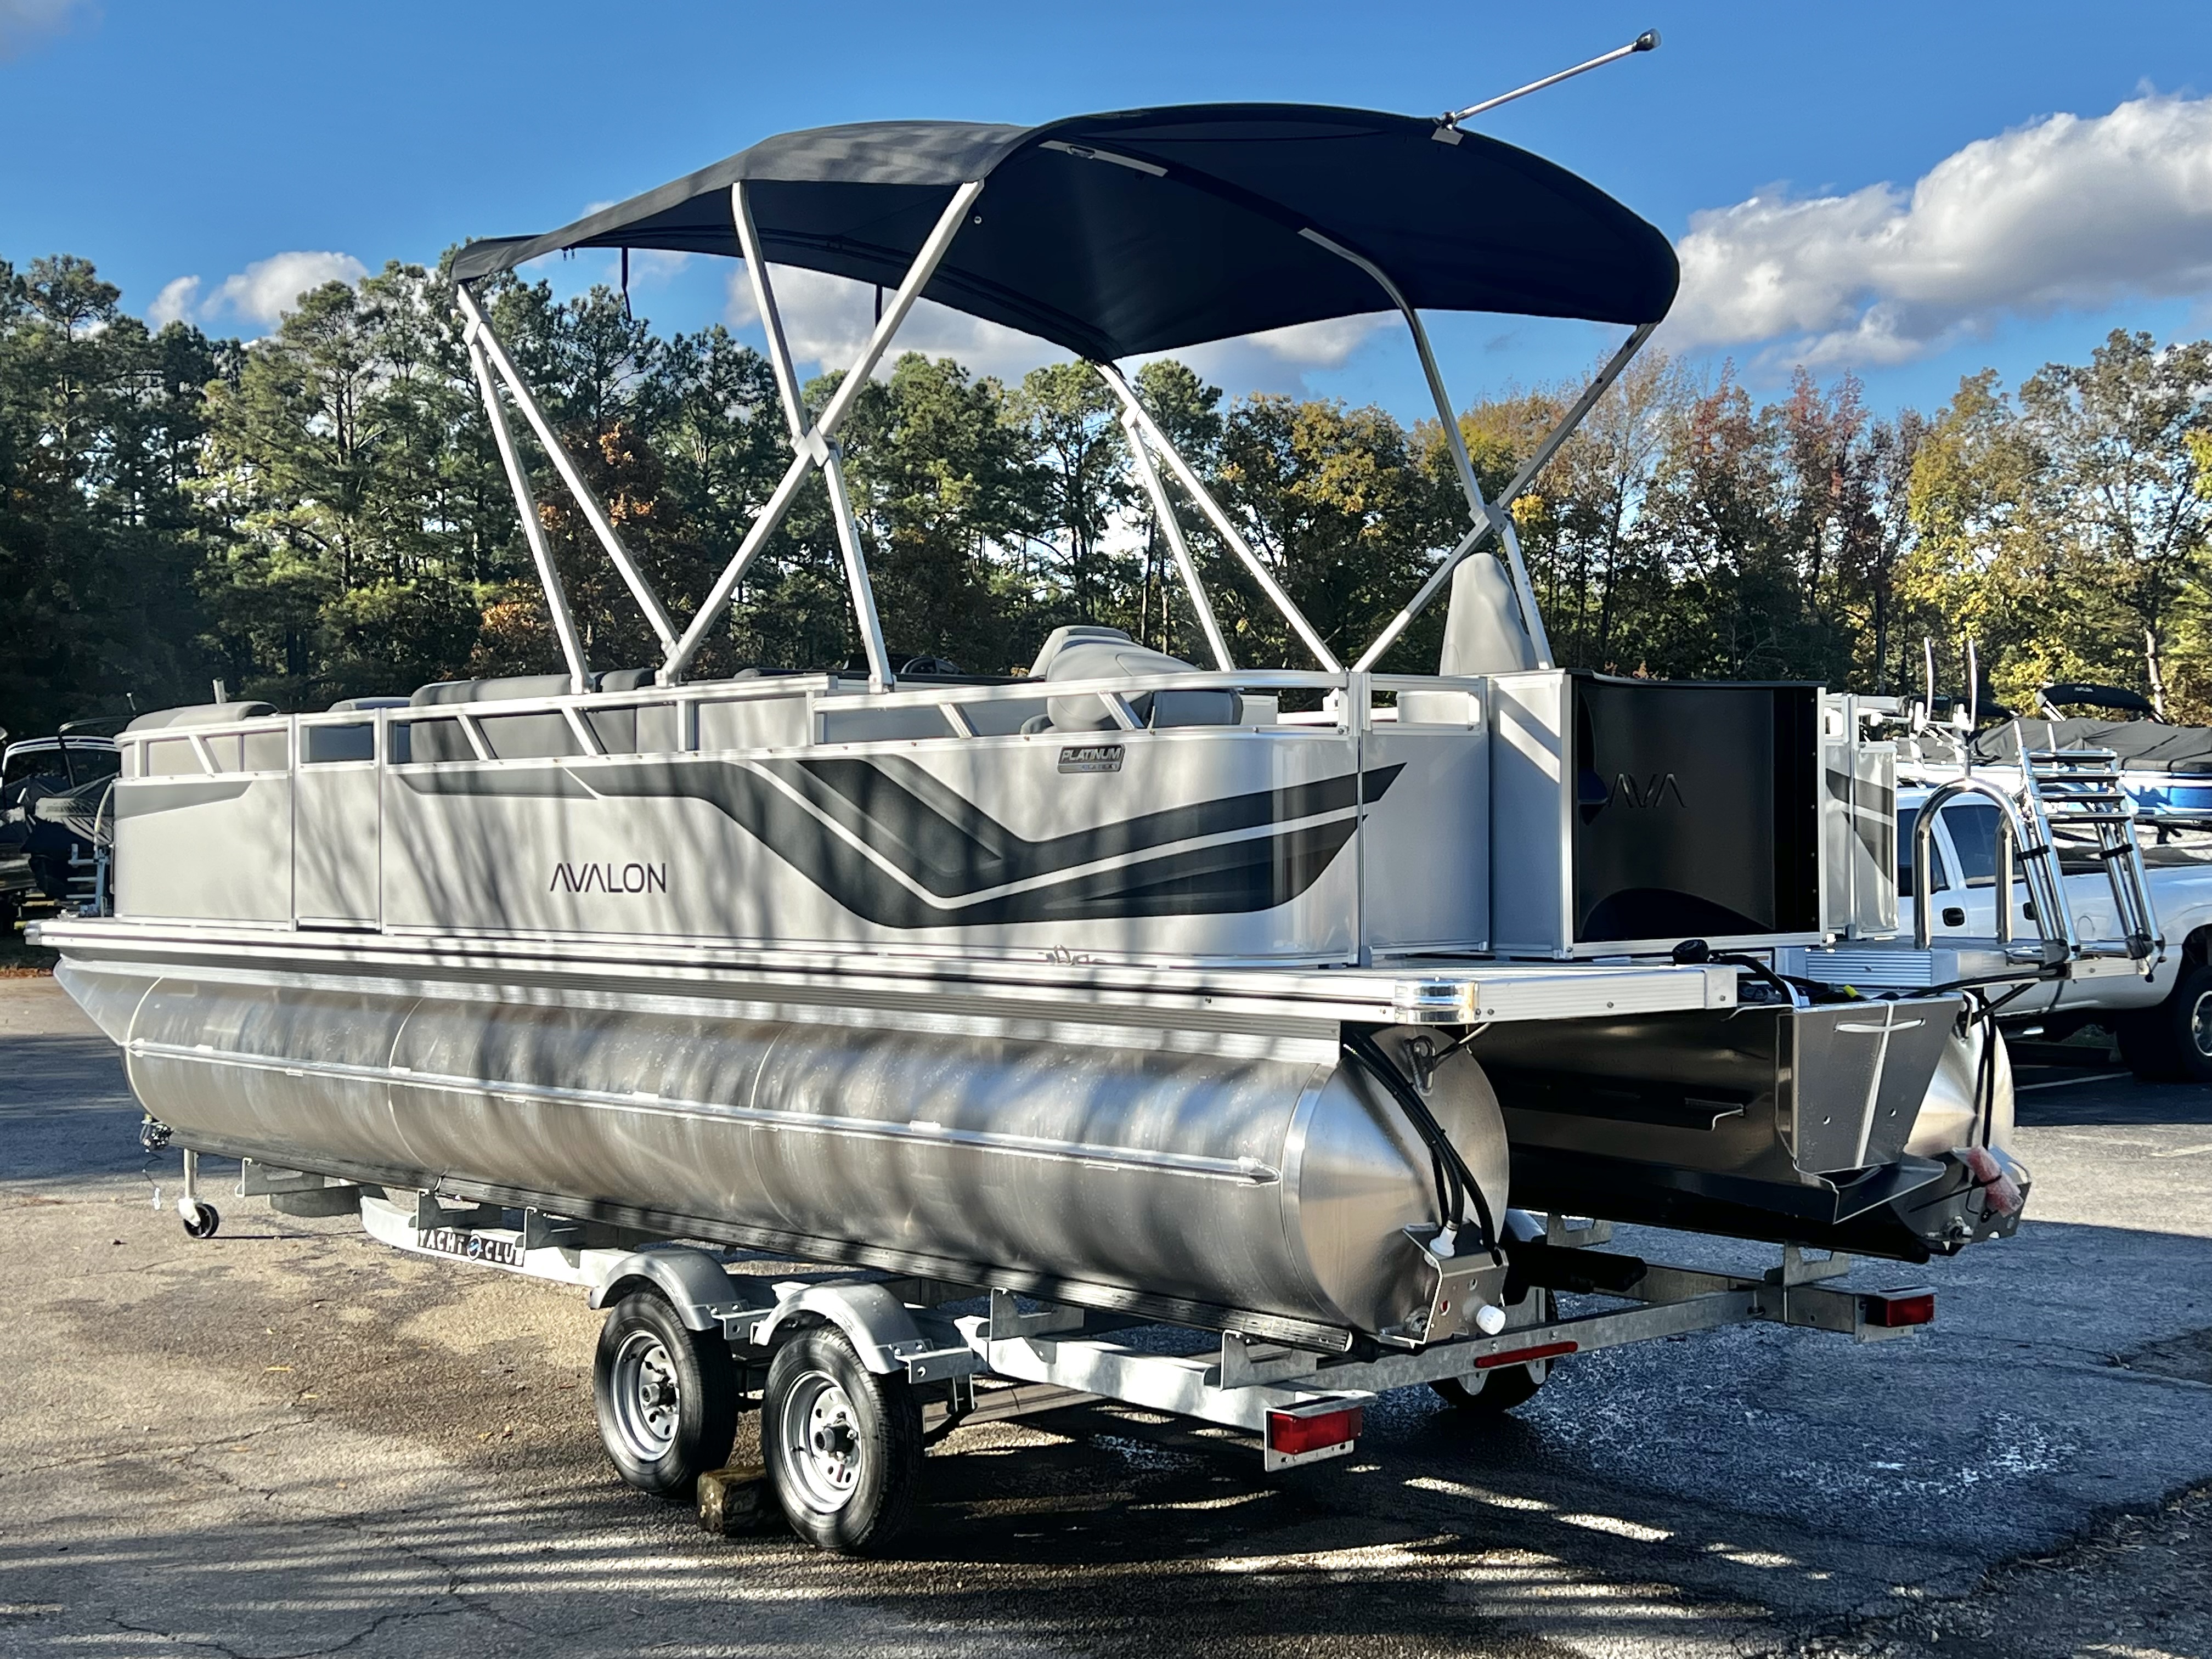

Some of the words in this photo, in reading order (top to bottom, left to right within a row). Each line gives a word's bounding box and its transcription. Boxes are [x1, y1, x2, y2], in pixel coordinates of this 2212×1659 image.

[1061, 747, 1122, 762] PLATINUM
[550, 863, 666, 893] AVALON
[419, 1229, 465, 1254] YACHT
